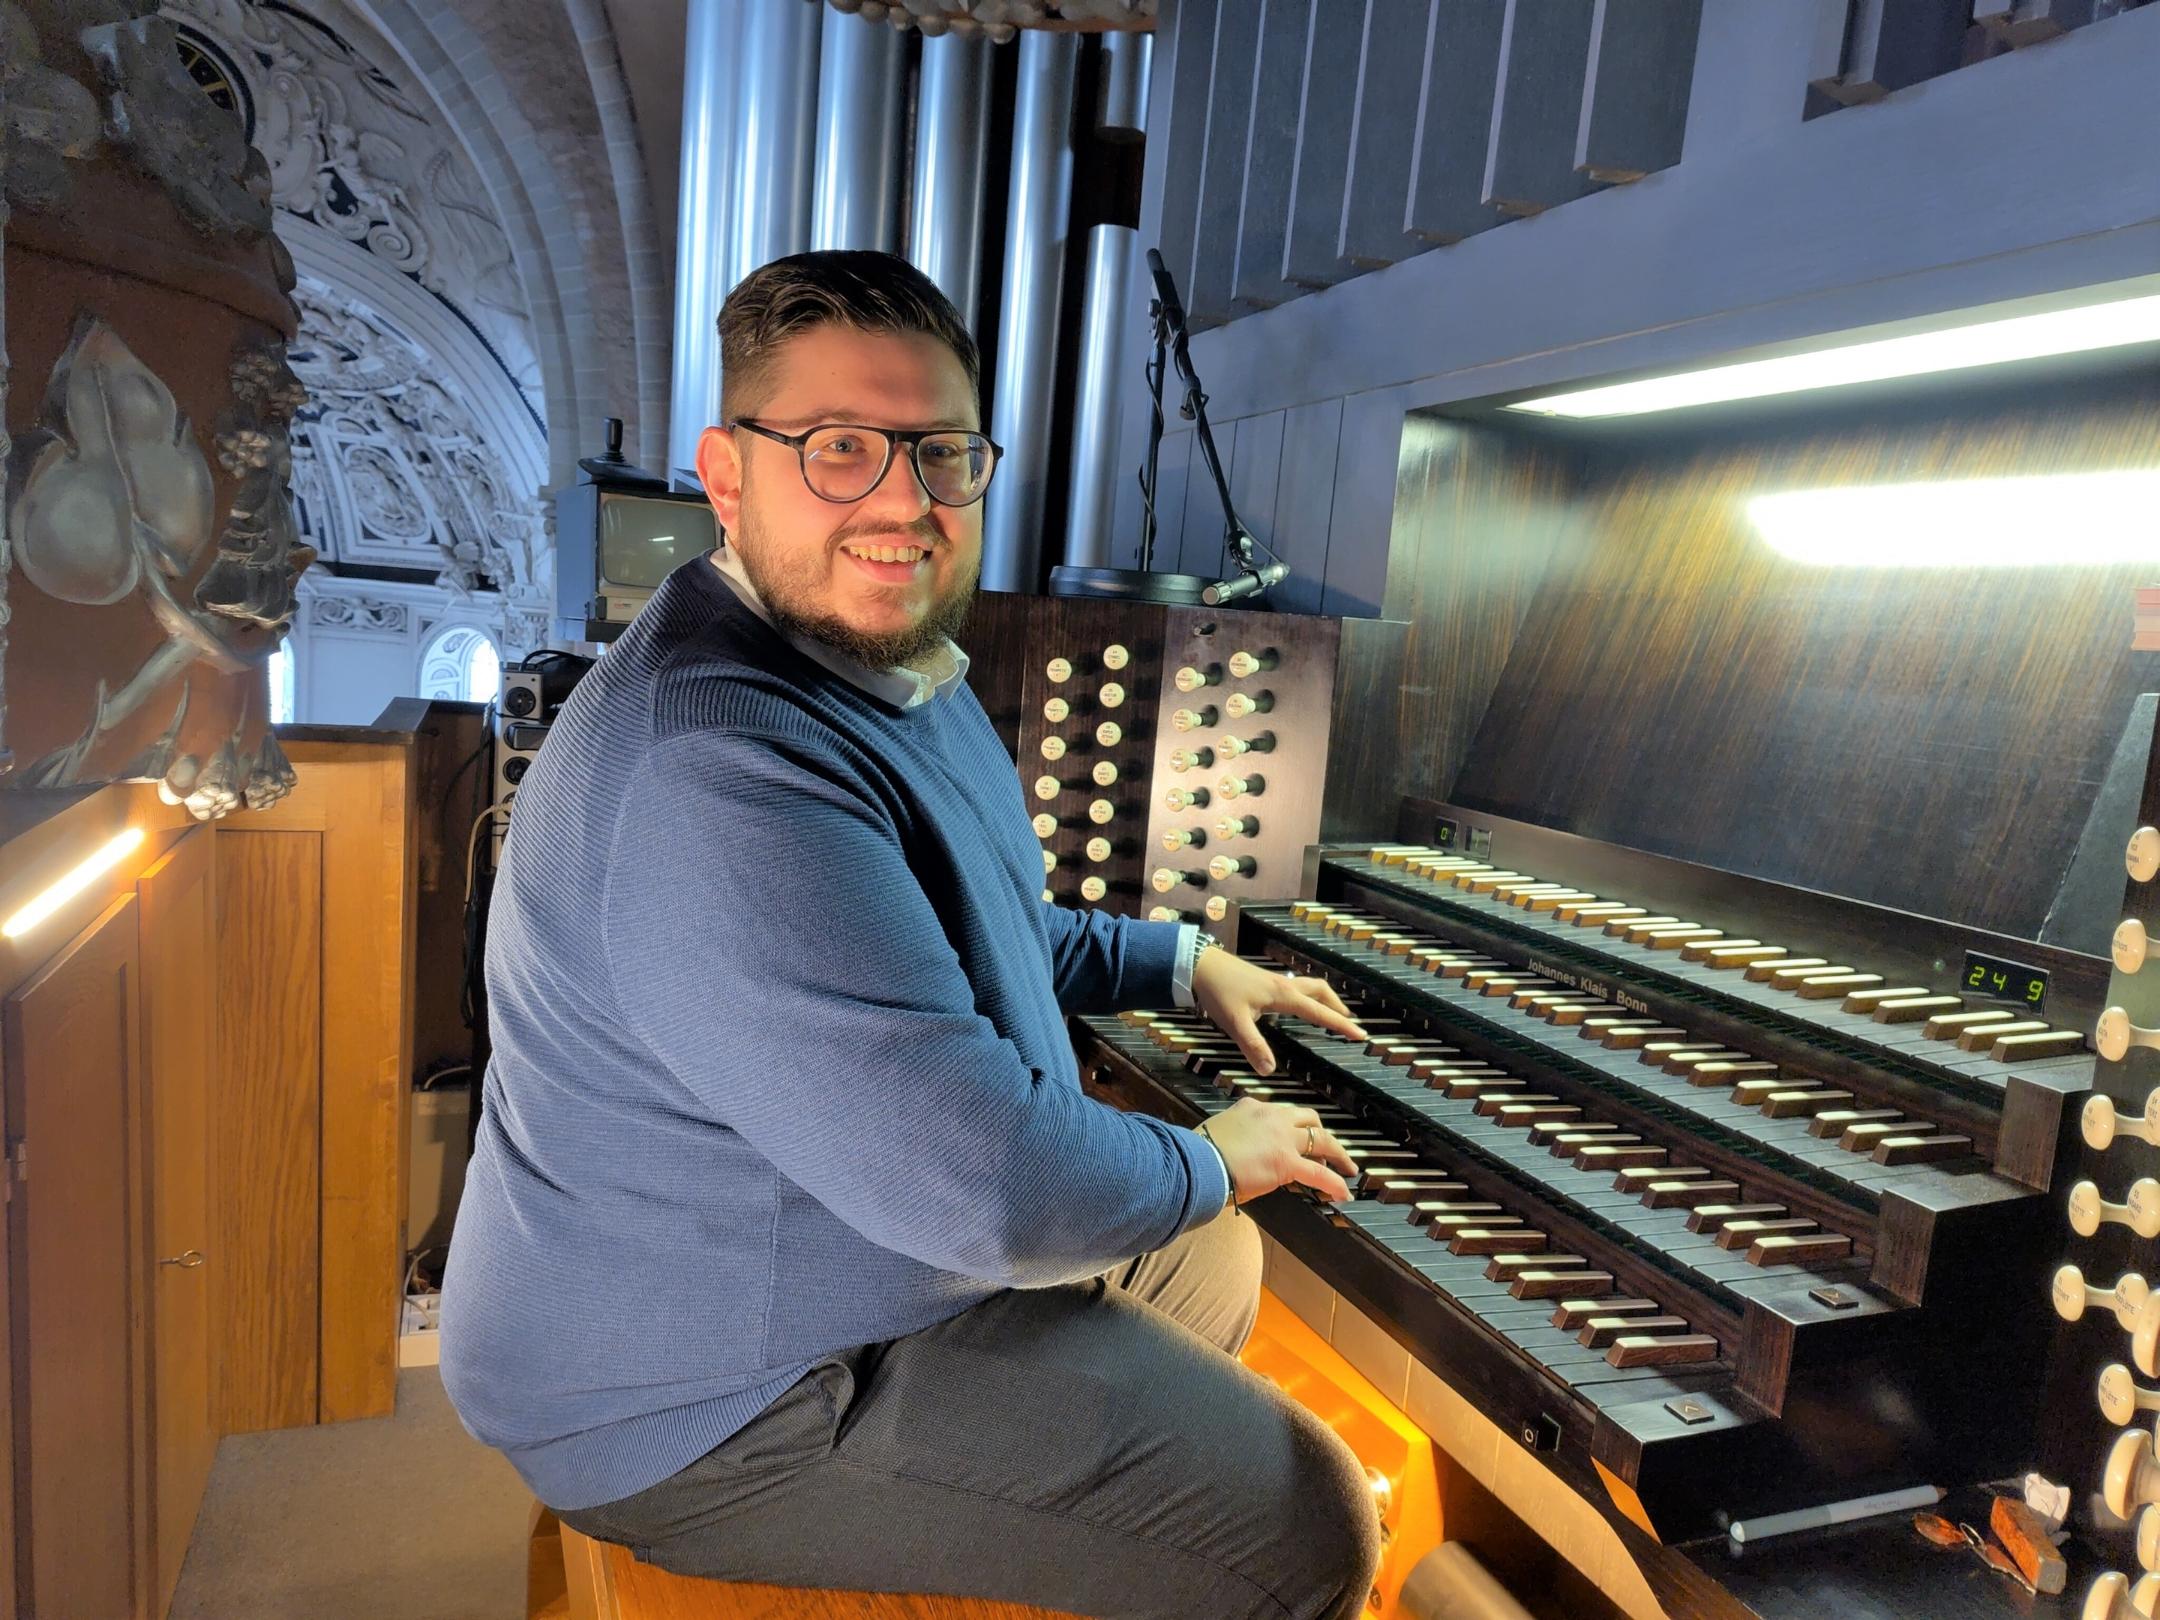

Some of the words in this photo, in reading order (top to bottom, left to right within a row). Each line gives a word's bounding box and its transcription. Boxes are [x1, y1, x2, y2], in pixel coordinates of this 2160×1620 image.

[1528, 958, 1576, 987] Johannes
[1580, 976, 1608, 999] Klais
[1616, 990, 1648, 1014] Bonn
[2027, 980, 2043, 1001] 9
